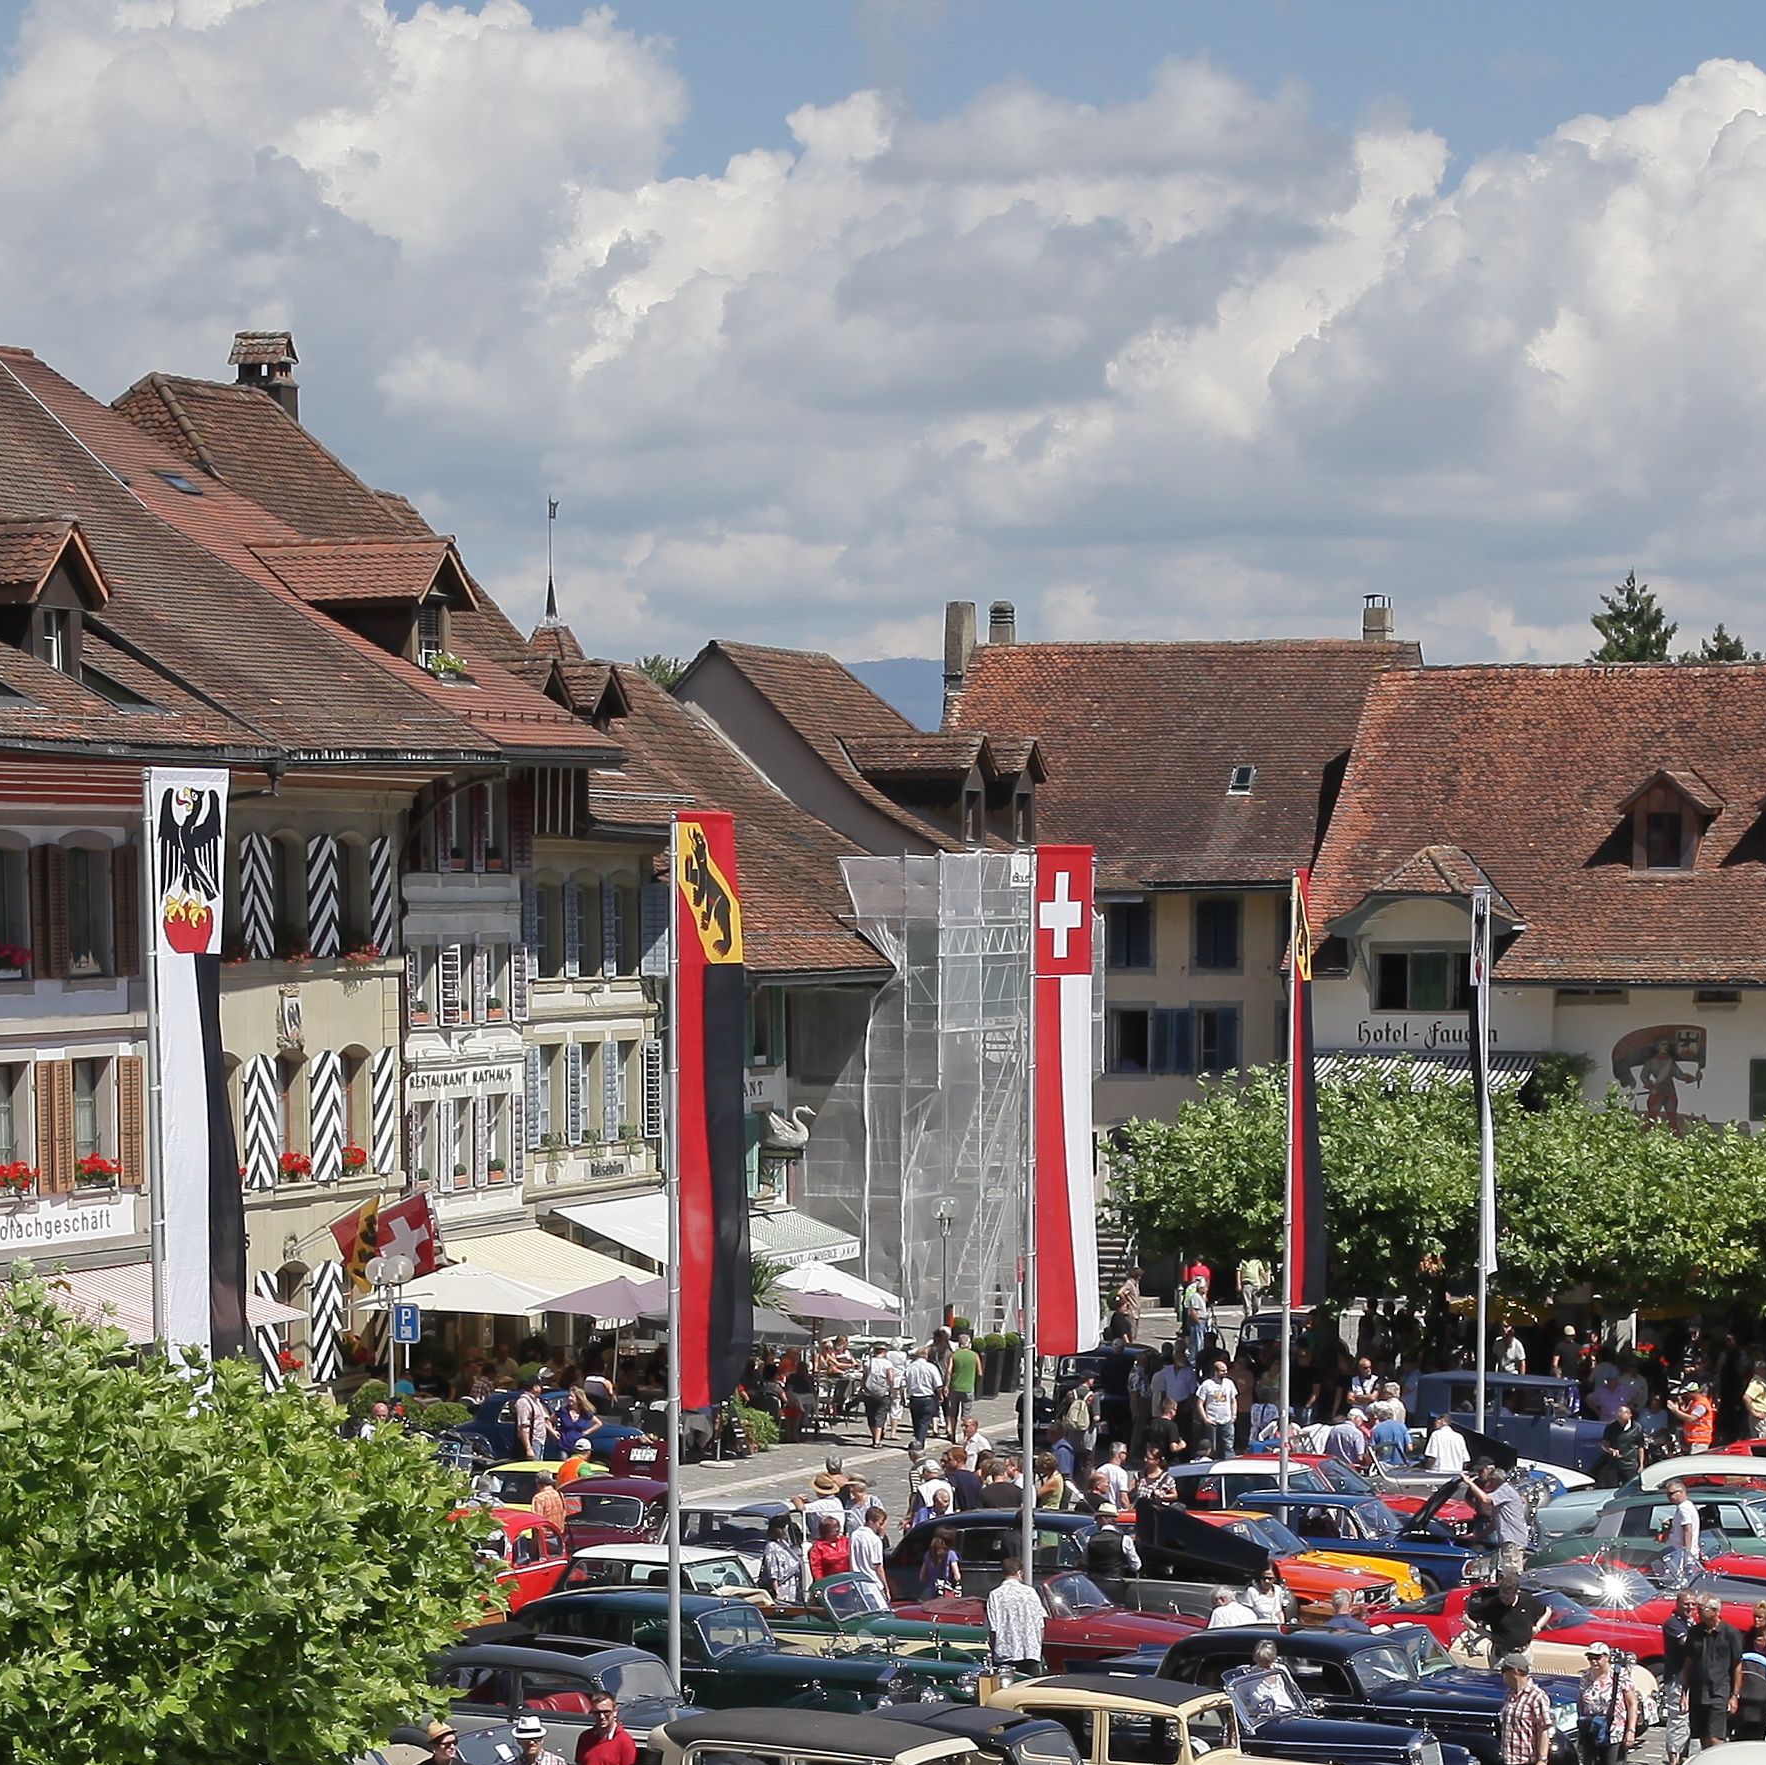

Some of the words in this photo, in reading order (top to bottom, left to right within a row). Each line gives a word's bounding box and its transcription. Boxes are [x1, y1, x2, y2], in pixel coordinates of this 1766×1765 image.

[1357, 1020, 1409, 1047] Hotel
[409, 1072, 467, 1089] RESTAURANT
[472, 1067, 512, 1085] RATHAUS
[402, 1309, 411, 1325] P
